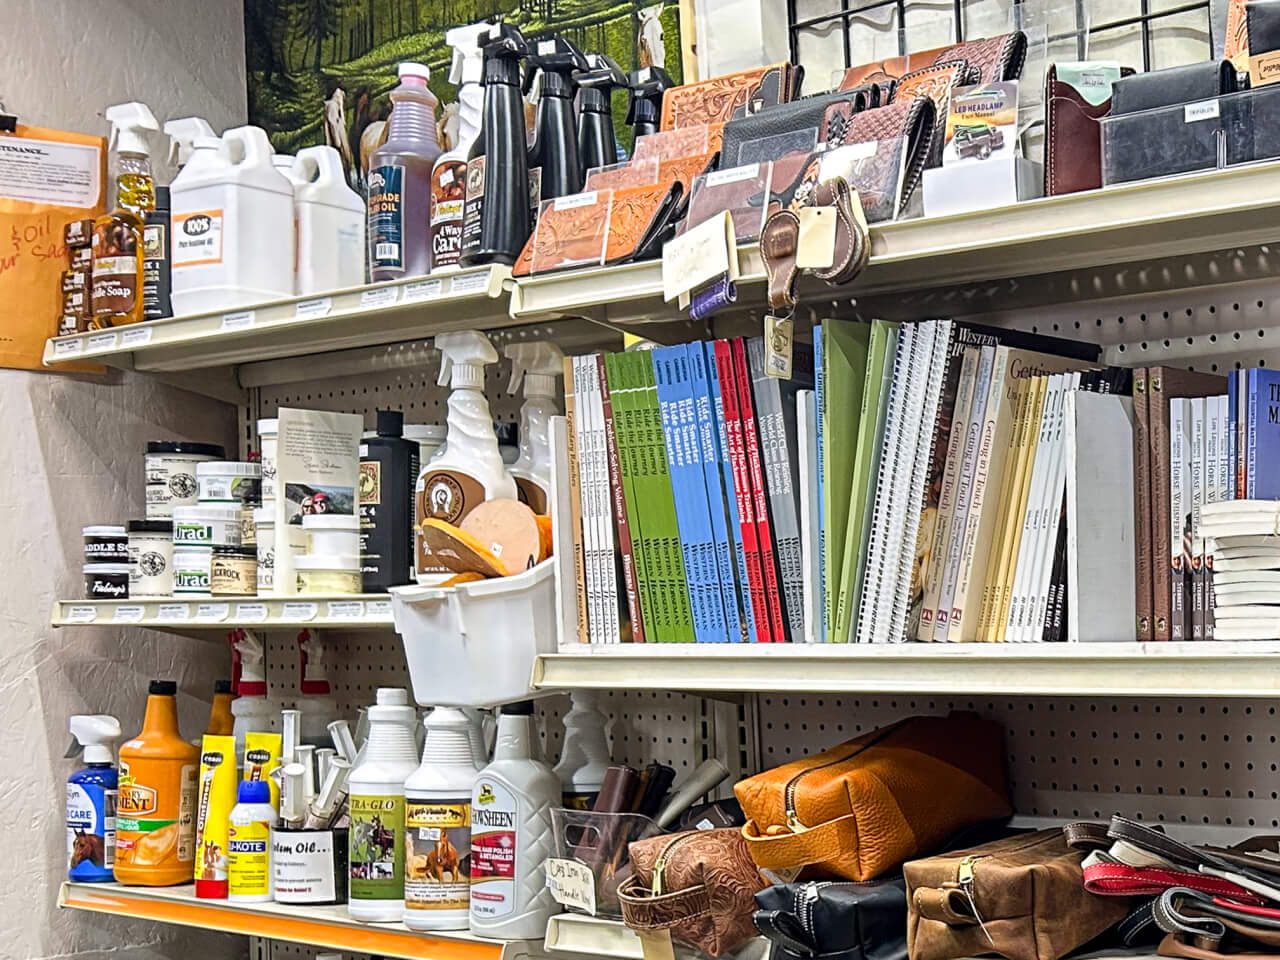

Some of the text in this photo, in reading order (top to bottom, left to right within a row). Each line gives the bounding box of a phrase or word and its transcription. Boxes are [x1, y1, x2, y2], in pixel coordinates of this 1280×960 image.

[967, 101, 1005, 113] HEADLAMP
[380, 203, 398, 211] OIL
[187, 217, 211, 232] 100%
[445, 225, 462, 235] Way
[107, 285, 131, 298] Soap
[660, 402, 674, 465] Ride Smarter
[669, 402, 683, 467] Ride Smarter
[678, 400, 692, 465] Ride Smarter
[685, 398, 700, 464] Ride Smarter
[947, 420, 964, 460] Getting
[964, 422, 980, 460] Getting
[605, 418, 621, 484] Problem-Solving
[615, 486, 625, 517] Volume
[1220, 458, 1228, 487] HORSE
[175, 525, 208, 540] Urad
[351, 799, 394, 810] TRA-GLO
[70, 810, 92, 819] CARE
[229, 841, 262, 852] U-KOTE
